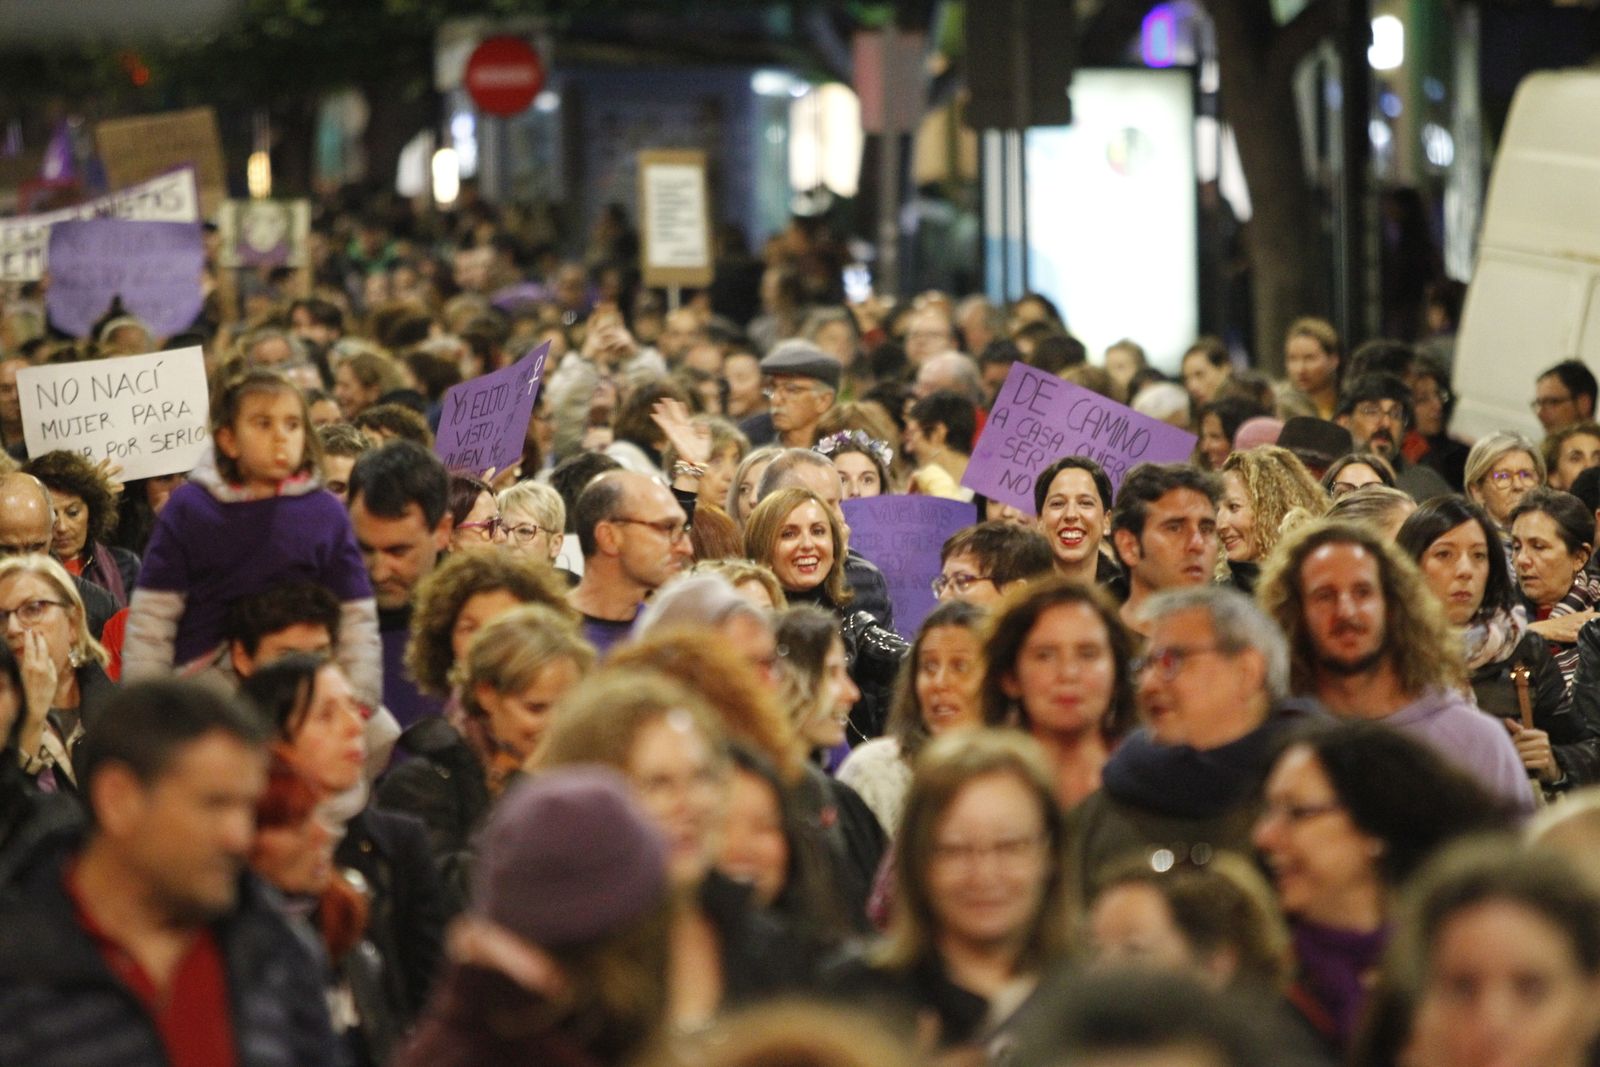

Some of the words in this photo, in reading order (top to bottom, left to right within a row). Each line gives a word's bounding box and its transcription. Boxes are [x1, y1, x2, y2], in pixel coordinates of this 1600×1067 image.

[36, 377, 80, 410] NO
[91, 360, 164, 402] NACÍ
[41, 411, 115, 441] MUJER
[131, 400, 193, 425] PARA
[450, 390, 468, 426] YO
[1012, 371, 1059, 416] DE
[1066, 398, 1151, 458] CAMINO
[106, 436, 144, 458] POR
[150, 425, 206, 454] SERLO
[991, 407, 1010, 430] A
[1015, 417, 1065, 452] CASA
[1073, 442, 1127, 483] QUIER
[999, 436, 1045, 471] SER
[998, 469, 1033, 496] NO
